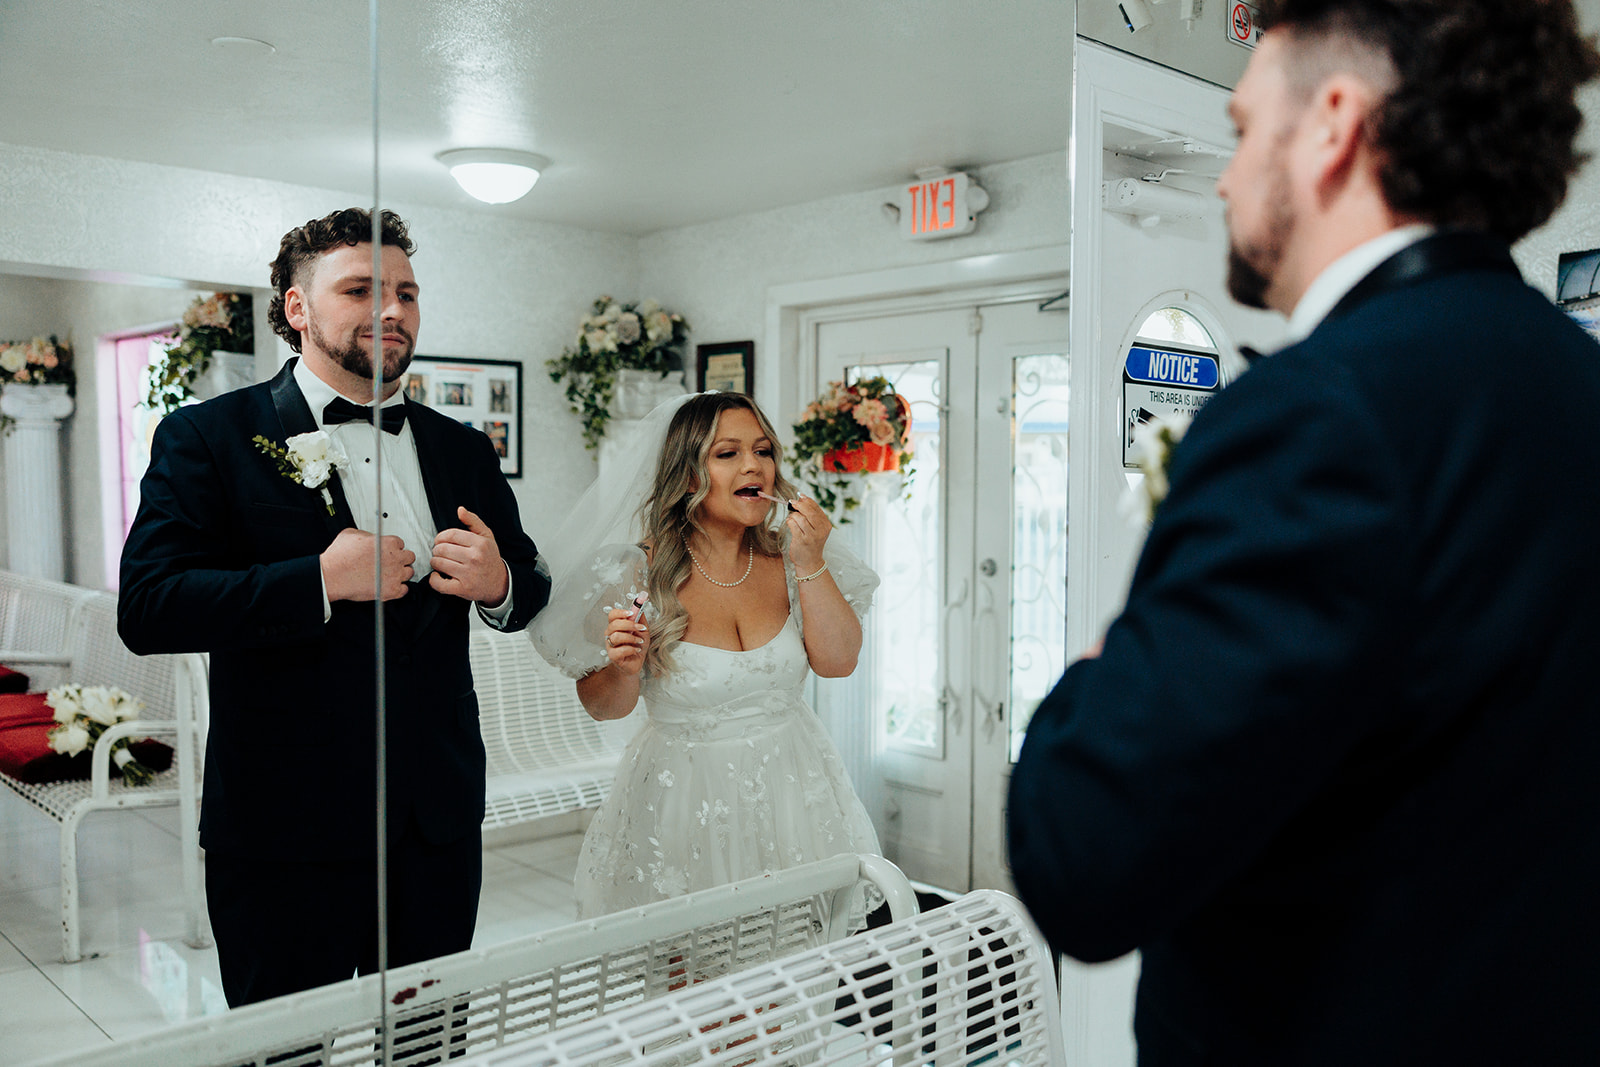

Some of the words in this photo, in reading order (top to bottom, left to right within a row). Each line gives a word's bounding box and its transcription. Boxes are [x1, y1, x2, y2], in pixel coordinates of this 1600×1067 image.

[1148, 352, 1200, 383] NOTICE
[1149, 390, 1164, 403] THIS
[1165, 392, 1183, 404] AREA
[1184, 394, 1191, 406] IS
